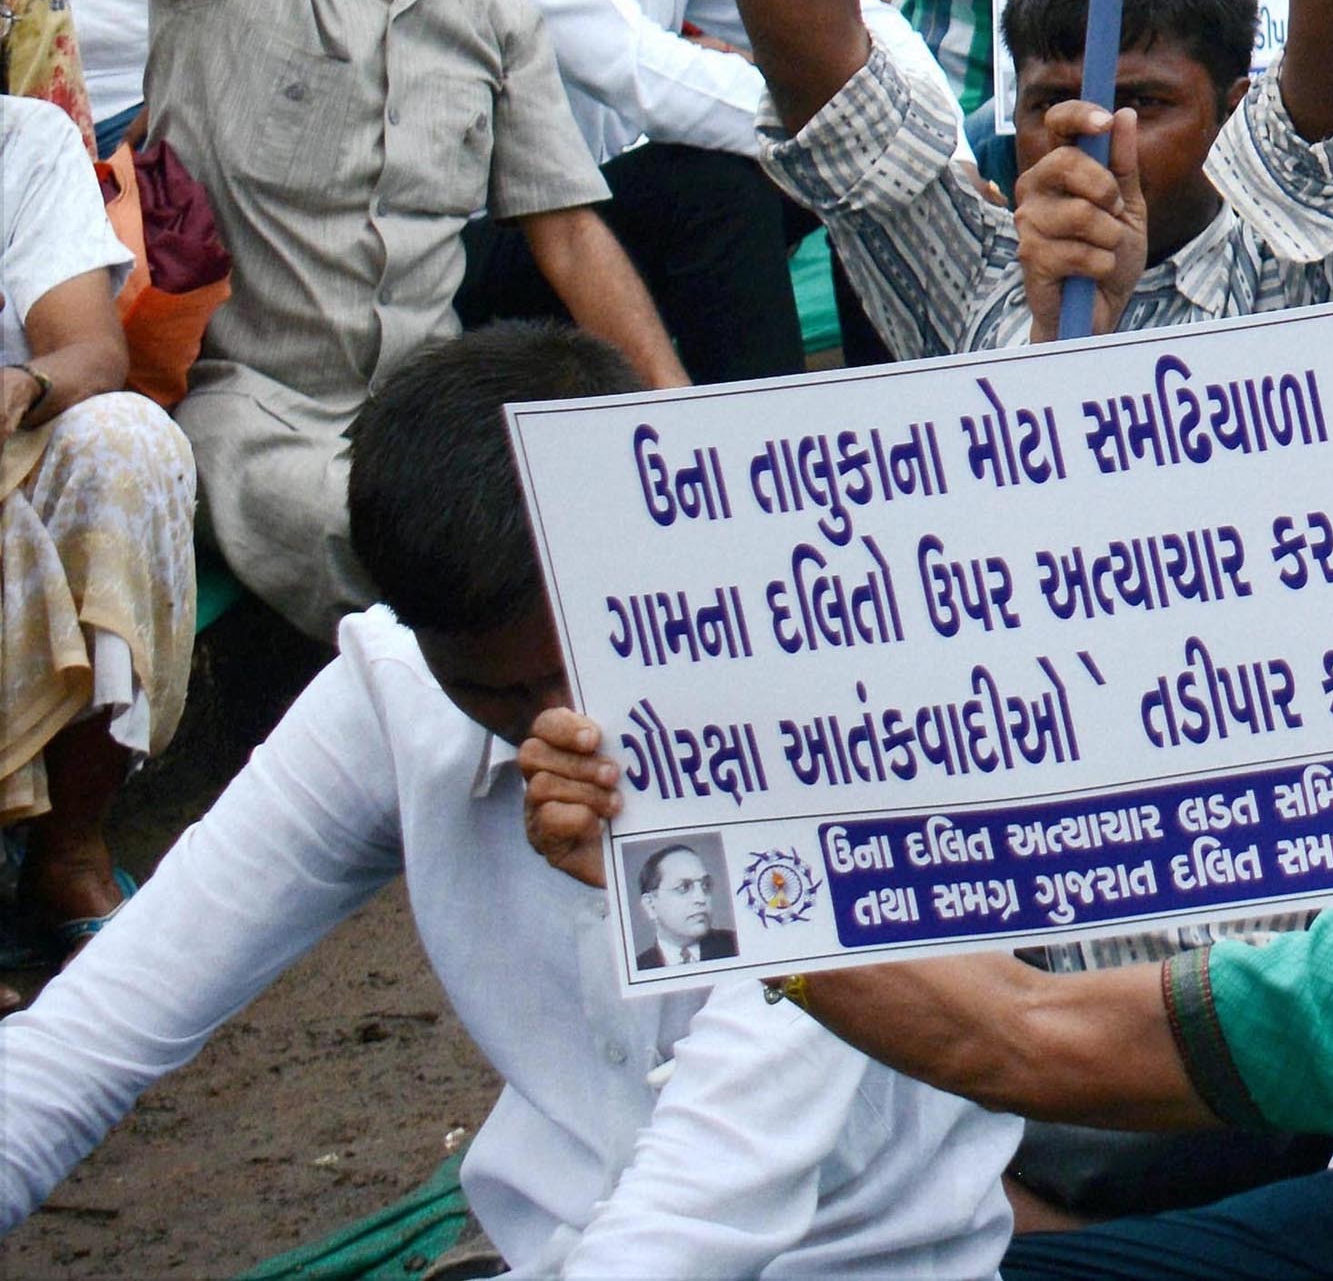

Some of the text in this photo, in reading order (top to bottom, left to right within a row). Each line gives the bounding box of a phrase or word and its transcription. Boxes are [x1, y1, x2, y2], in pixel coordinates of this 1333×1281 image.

[634, 355, 1328, 546] ઉના તાલુકાના મોટા સમઢિયાળા
[606, 587, 752, 666] ગામના
[766, 536, 904, 654] દલિતો
[918, 535, 1020, 637] ઉપર
[1036, 526, 1252, 619] અત્યાચાર
[621, 637, 1302, 806] ગૌરક્ષા તડીપાર
[827, 826, 894, 873] ઉના
[906, 816, 994, 866] દલિત
[1007, 805, 1163, 856] અત્યાચાર
[1179, 790, 1259, 831] લડત
[854, 879, 919, 926] તથા
[932, 870, 1020, 919] સમગ્ર
[1036, 860, 1157, 924] ગુજરાત
[1171, 836, 1262, 890] દલિત
